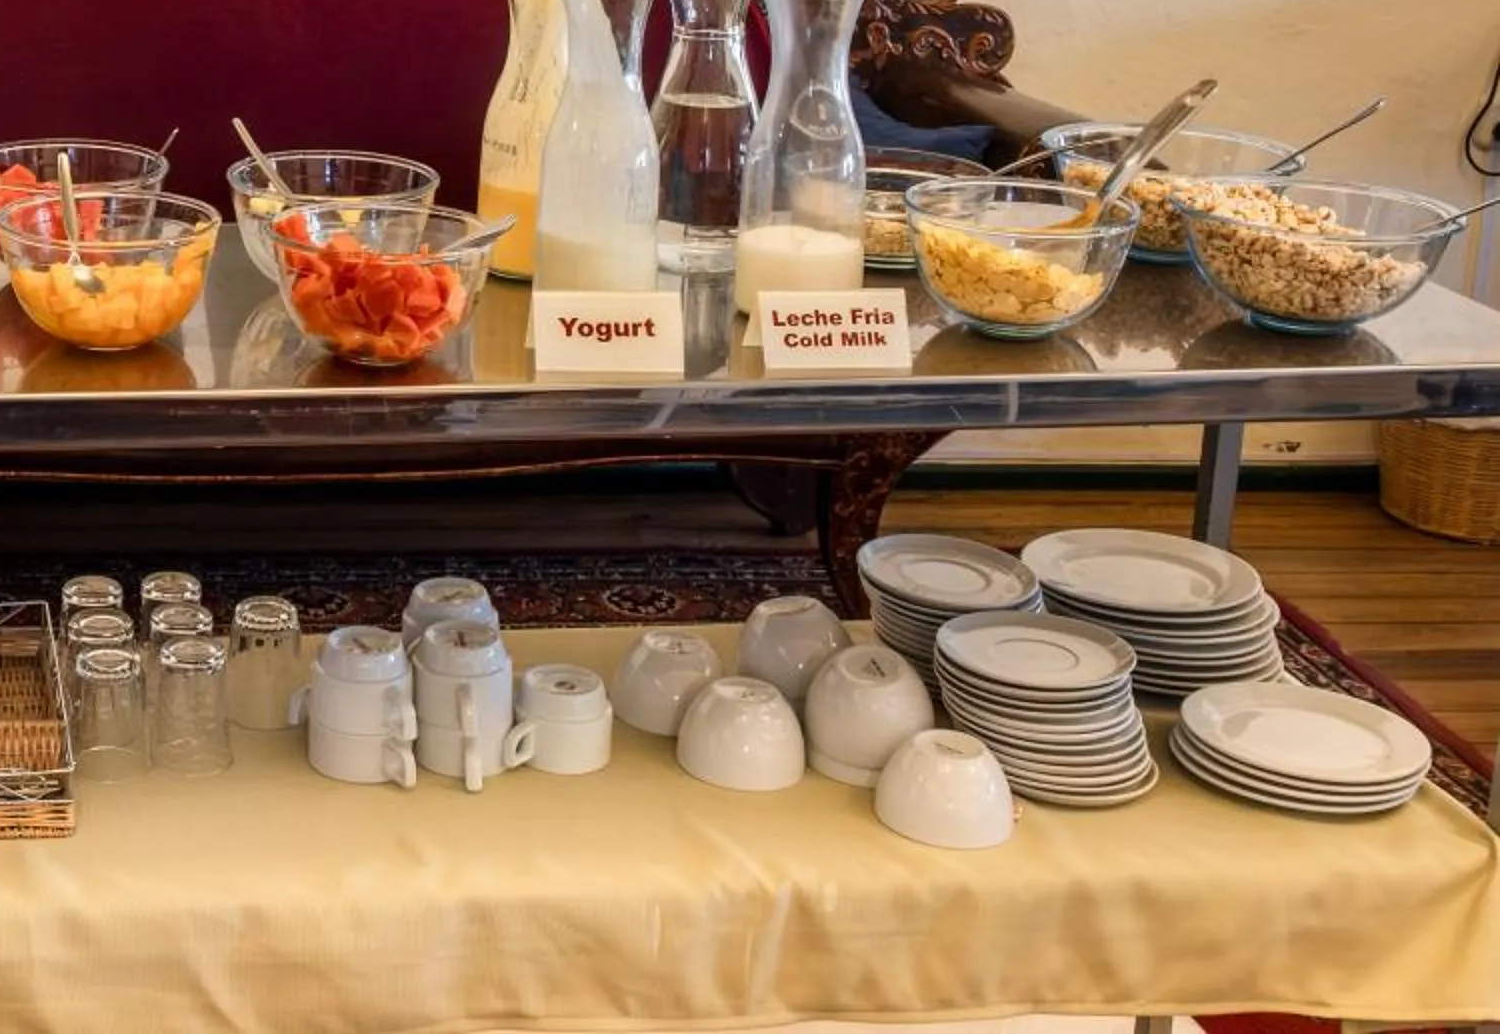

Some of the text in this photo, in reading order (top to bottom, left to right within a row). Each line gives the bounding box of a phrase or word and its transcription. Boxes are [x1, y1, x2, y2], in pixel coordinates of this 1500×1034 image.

[771, 307, 895, 326] Leche Fria
[557, 317, 656, 343] Yogurt
[783, 331, 887, 347] Cold Milk
